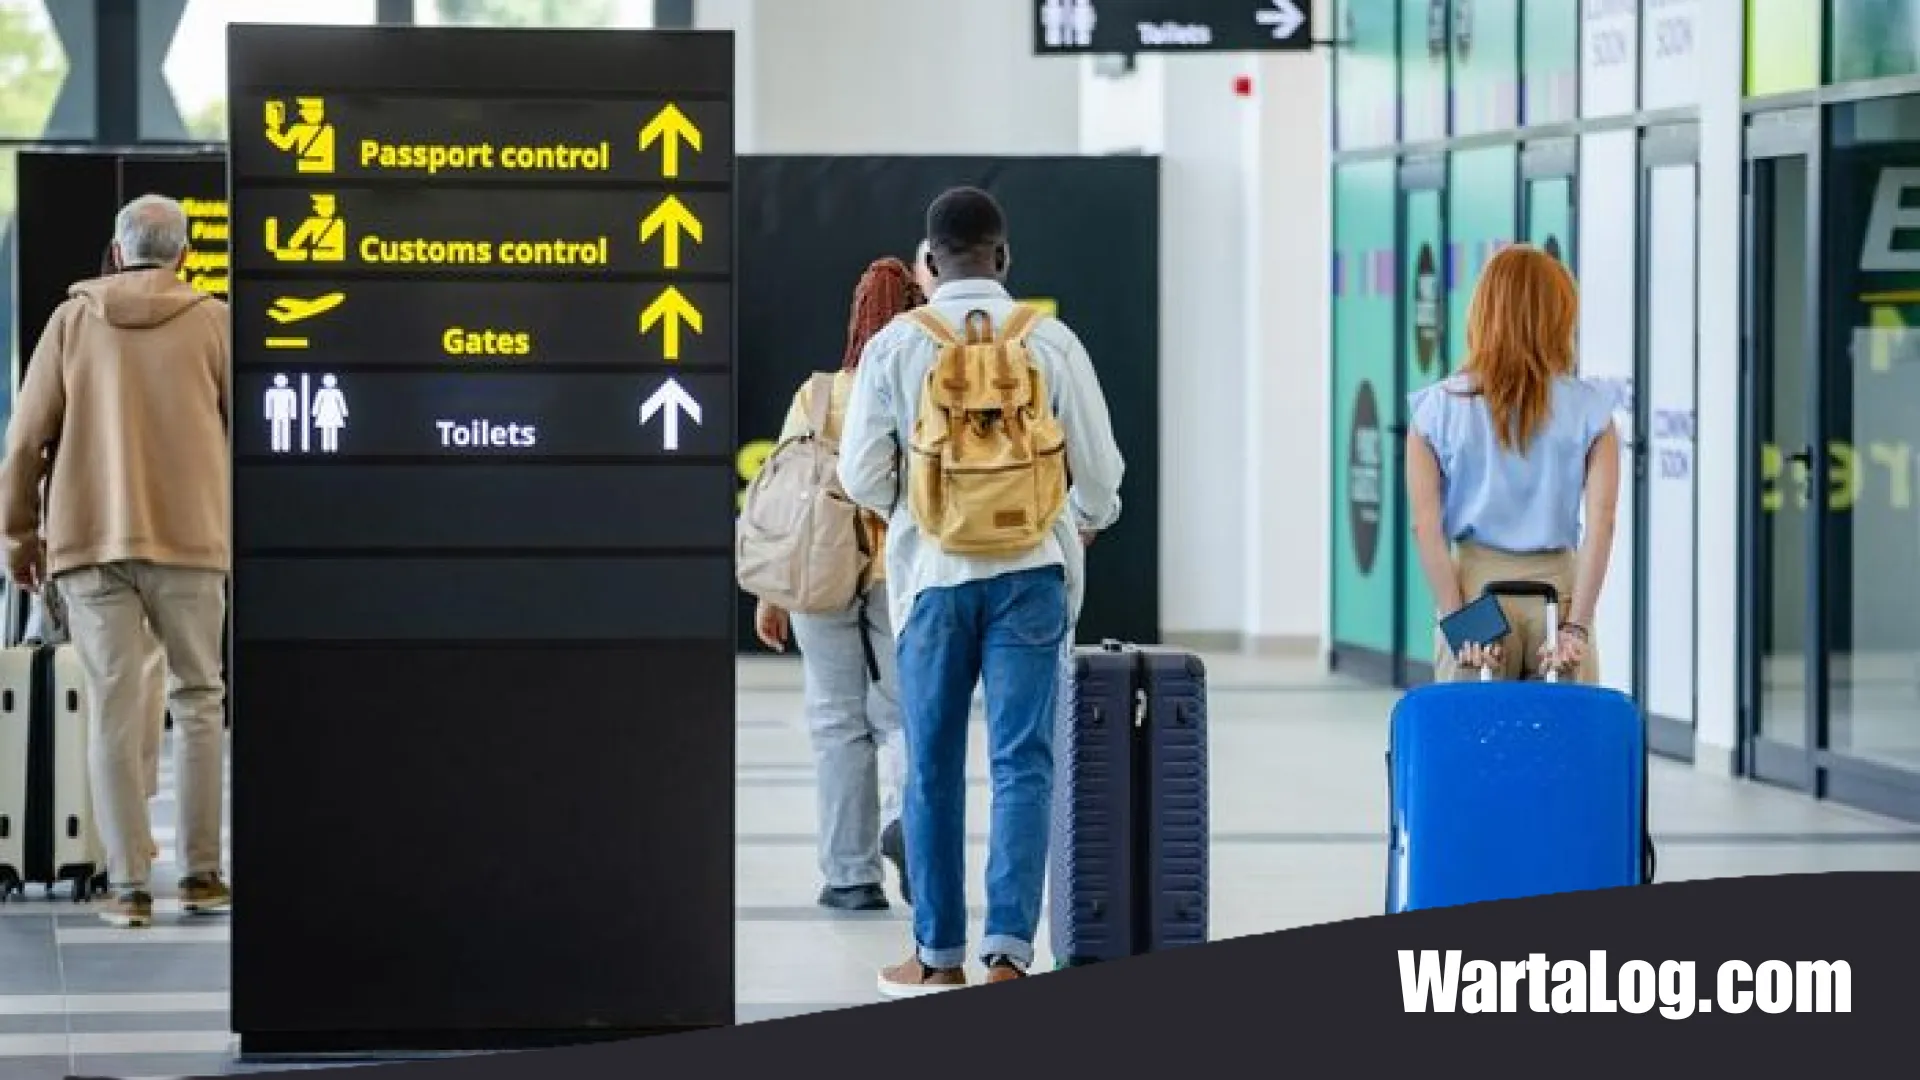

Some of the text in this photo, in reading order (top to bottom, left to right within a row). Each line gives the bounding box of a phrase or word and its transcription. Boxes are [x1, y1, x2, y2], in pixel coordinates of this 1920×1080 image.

[361, 139, 610, 174] Passport control
[359, 235, 607, 264] Customs control
[442, 328, 530, 356] Gates
[436, 418, 536, 448] Toilets
